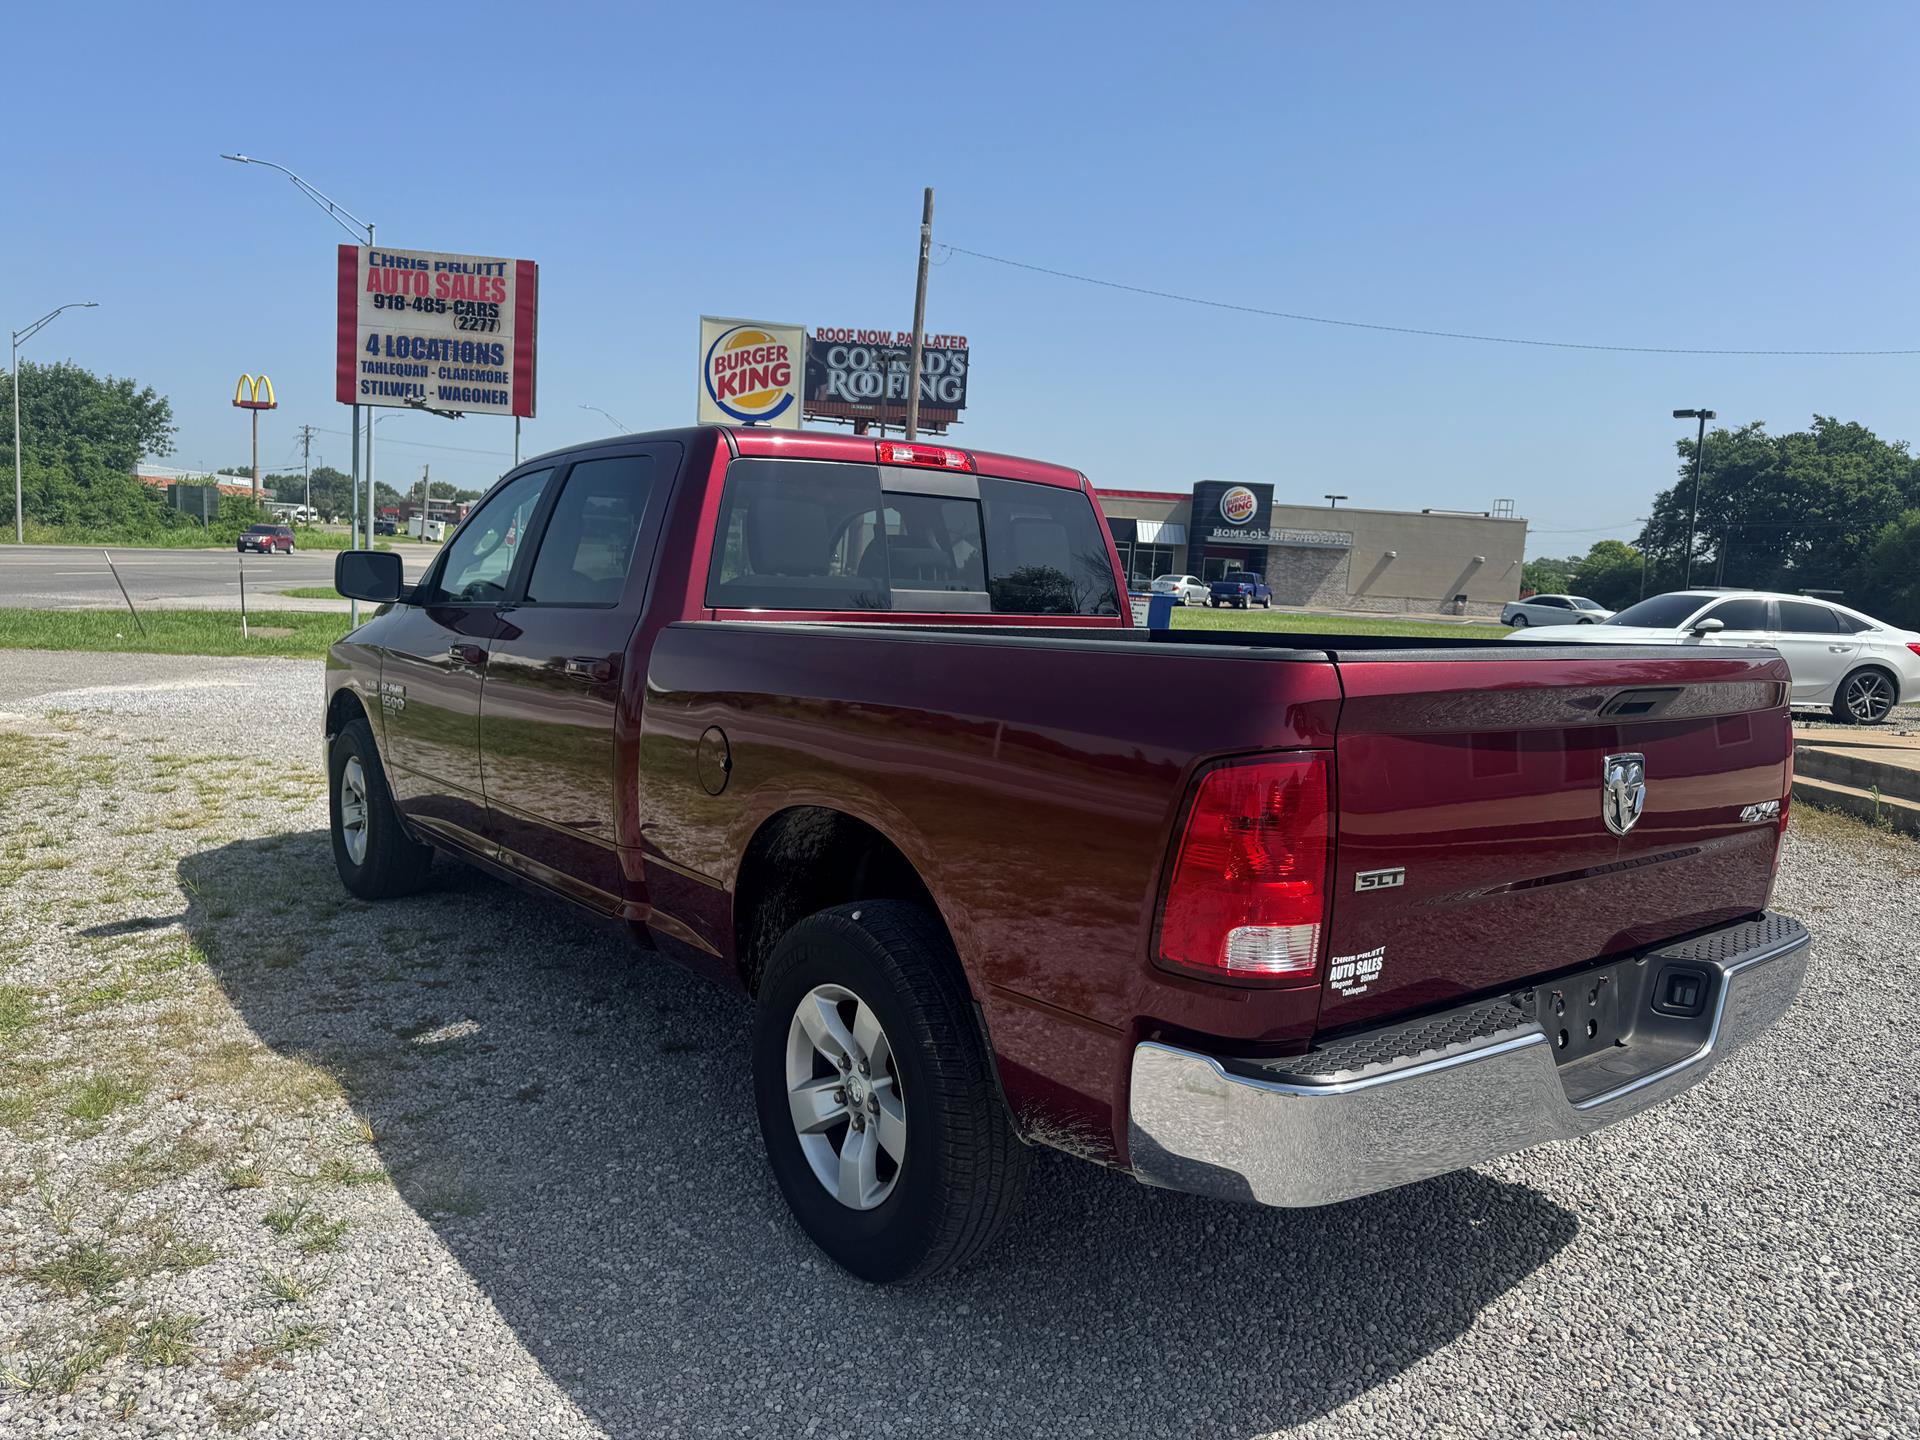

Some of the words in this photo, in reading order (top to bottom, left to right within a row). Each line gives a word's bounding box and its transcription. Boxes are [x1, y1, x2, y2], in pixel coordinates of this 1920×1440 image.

[369, 251, 429, 271] CHRIS
[434, 261, 507, 276] PRUITT
[366, 267, 430, 298] AUTO
[435, 272, 506, 304] SALES
[373, 293, 500, 319] 918-485-CARS
[453, 315, 501, 333] (2277)
[366, 333, 380, 356] 4
[385, 335, 505, 366] LOCATIONS
[816, 327, 854, 343] ROOF
[857, 331, 894, 348] NOW,
[924, 334, 968, 349] LATER
[361, 360, 428, 378] TAHLEQUAH
[438, 366, 509, 384] CLAREMORE
[714, 345, 788, 375] BURGER
[827, 345, 966, 377] COD'S
[361, 379, 425, 398] STILWELL
[438, 385, 508, 405] WAGONER
[717, 362, 791, 400] KING
[826, 369, 964, 403] ROOFING
[1226, 495, 1252, 506] BURGER
[1227, 500, 1253, 515] KING
[1213, 528, 1247, 538] HOME
[1250, 529, 1265, 539] OF
[1360, 872, 1404, 888] SLT
[1332, 956, 1355, 965] CHRIS
[1356, 946, 1386, 960] PRUITT
[1329, 963, 1355, 981] AUTO
[1356, 957, 1383, 975] SALES
[1331, 980, 1353, 990] Wagoner
